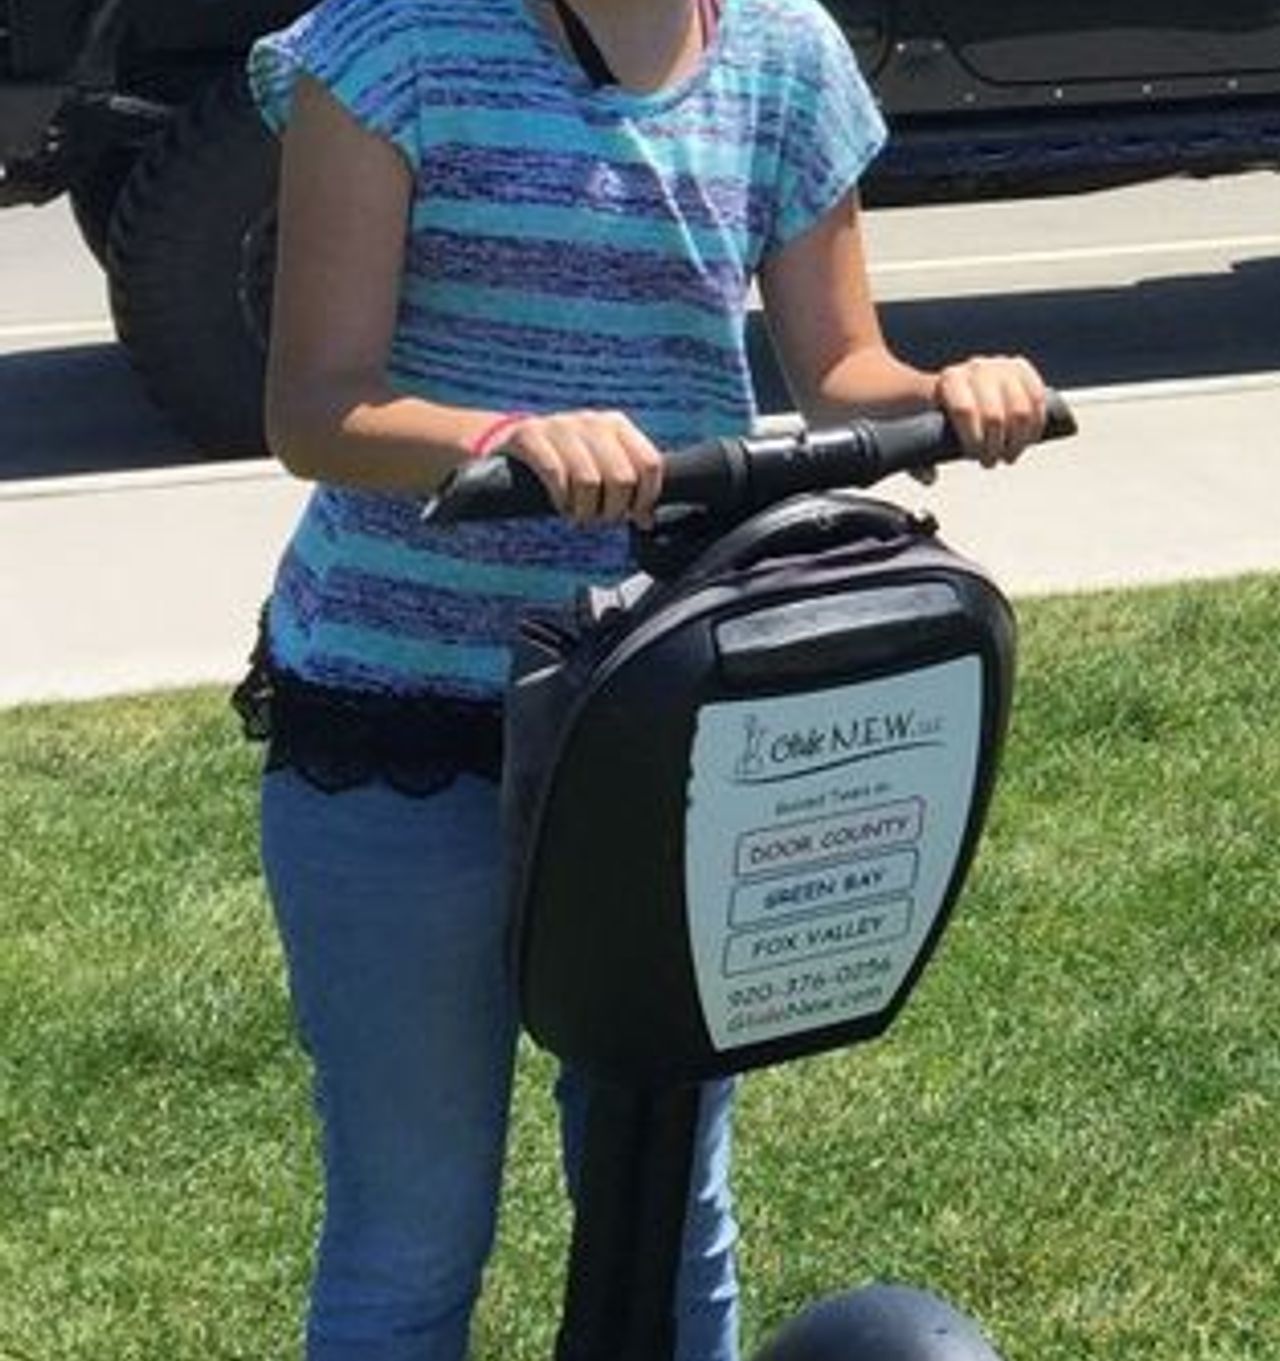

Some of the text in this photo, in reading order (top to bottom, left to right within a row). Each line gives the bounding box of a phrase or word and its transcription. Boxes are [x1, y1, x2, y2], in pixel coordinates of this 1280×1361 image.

[751, 817, 908, 865] DOOR COUNTY
[764, 868, 885, 911] GREEN BAY
[754, 913, 884, 958] FOX VALLEY
